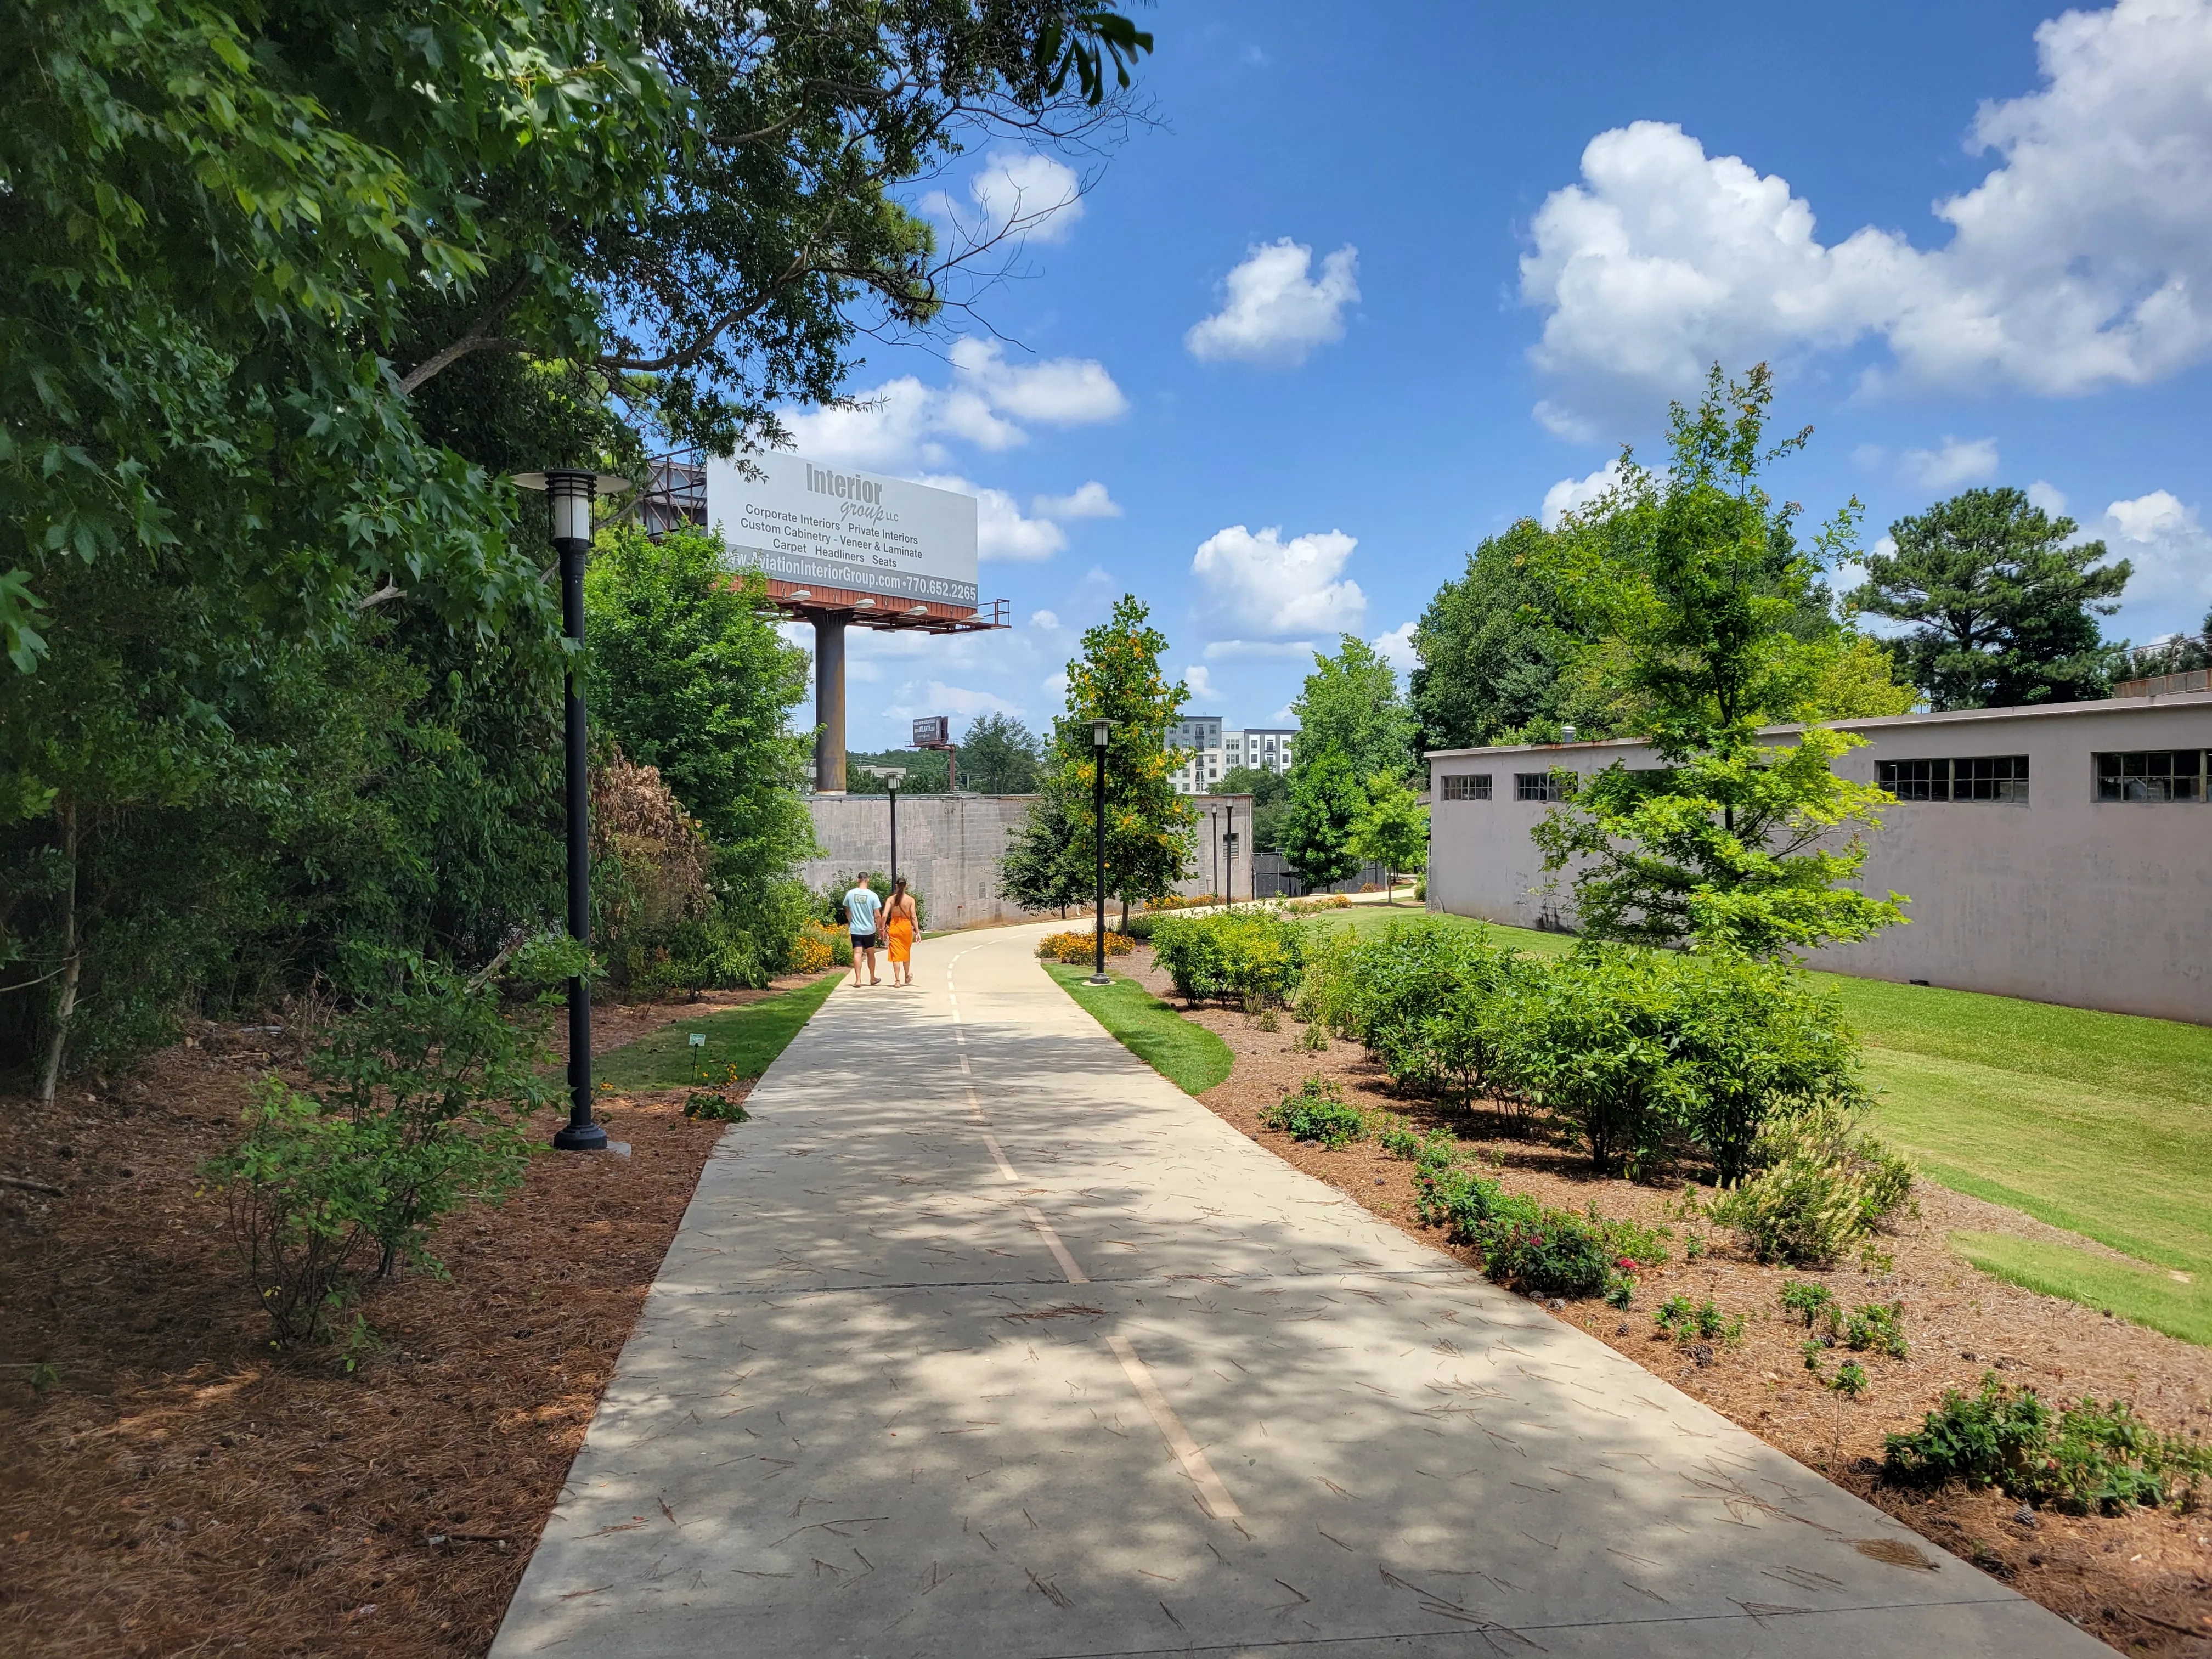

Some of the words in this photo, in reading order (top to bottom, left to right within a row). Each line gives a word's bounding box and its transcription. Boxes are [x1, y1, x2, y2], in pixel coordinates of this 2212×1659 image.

[806, 463, 882, 505] Interior
[746, 504, 797, 522] Corporate
[800, 514, 840, 531] Interiors
[848, 523, 880, 538] Private
[882, 529, 918, 545] Interiors
[840, 501, 885, 526] group
[886, 512, 899, 522] LLC
[741, 517, 781, 534] Custom
[784, 526, 831, 545] Cabinetry
[840, 535, 872, 550] Veneer
[874, 542, 881, 552] &
[883, 543, 923, 558] Laminate
[773, 538, 807, 554] Carpet
[815, 545, 865, 562] Headliners
[872, 555, 897, 567] Seats
